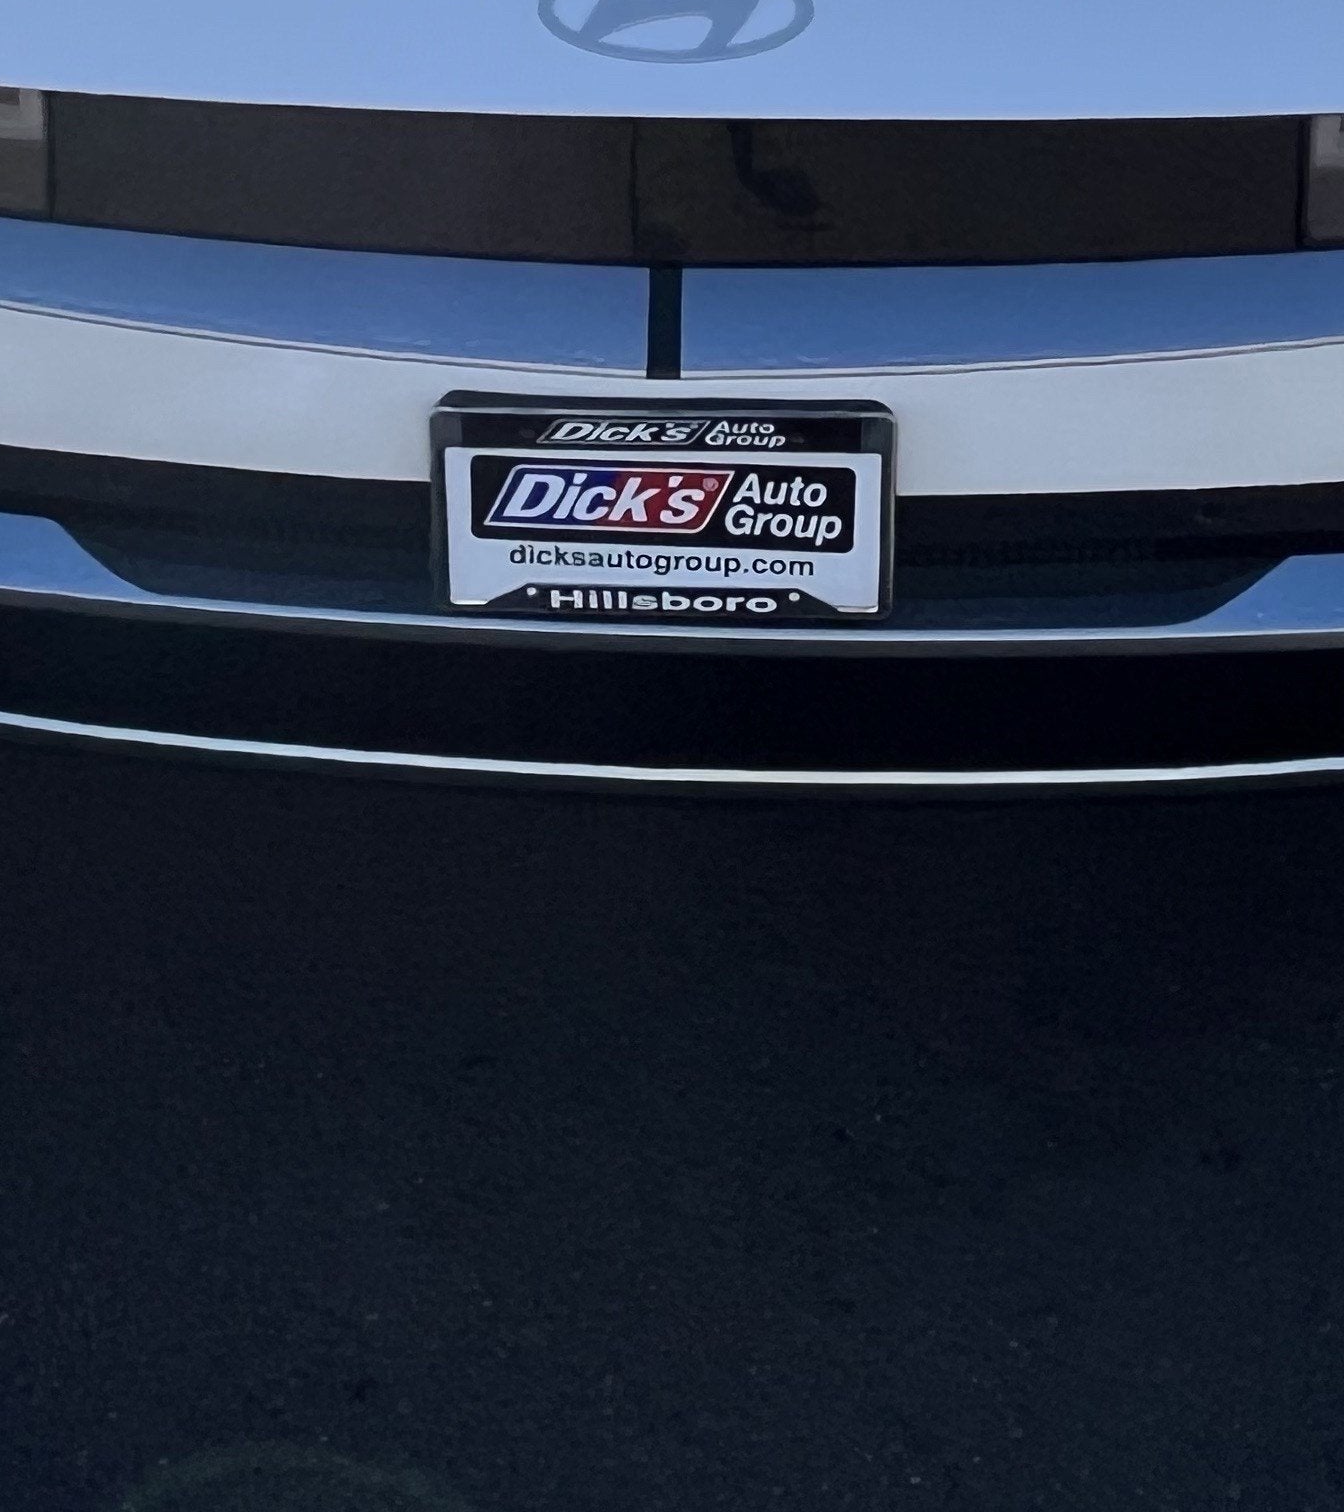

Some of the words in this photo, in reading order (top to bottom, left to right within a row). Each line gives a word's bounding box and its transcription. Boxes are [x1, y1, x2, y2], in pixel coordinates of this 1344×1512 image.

[550, 422, 692, 442] Dick's
[705, 433, 786, 448] Group
[711, 420, 775, 434] Auto
[502, 472, 706, 524] Dick's
[733, 472, 828, 507] Auto
[724, 503, 842, 546] Group
[509, 544, 815, 577] dicksautogroup.com
[550, 589, 778, 613] Hillsboro
